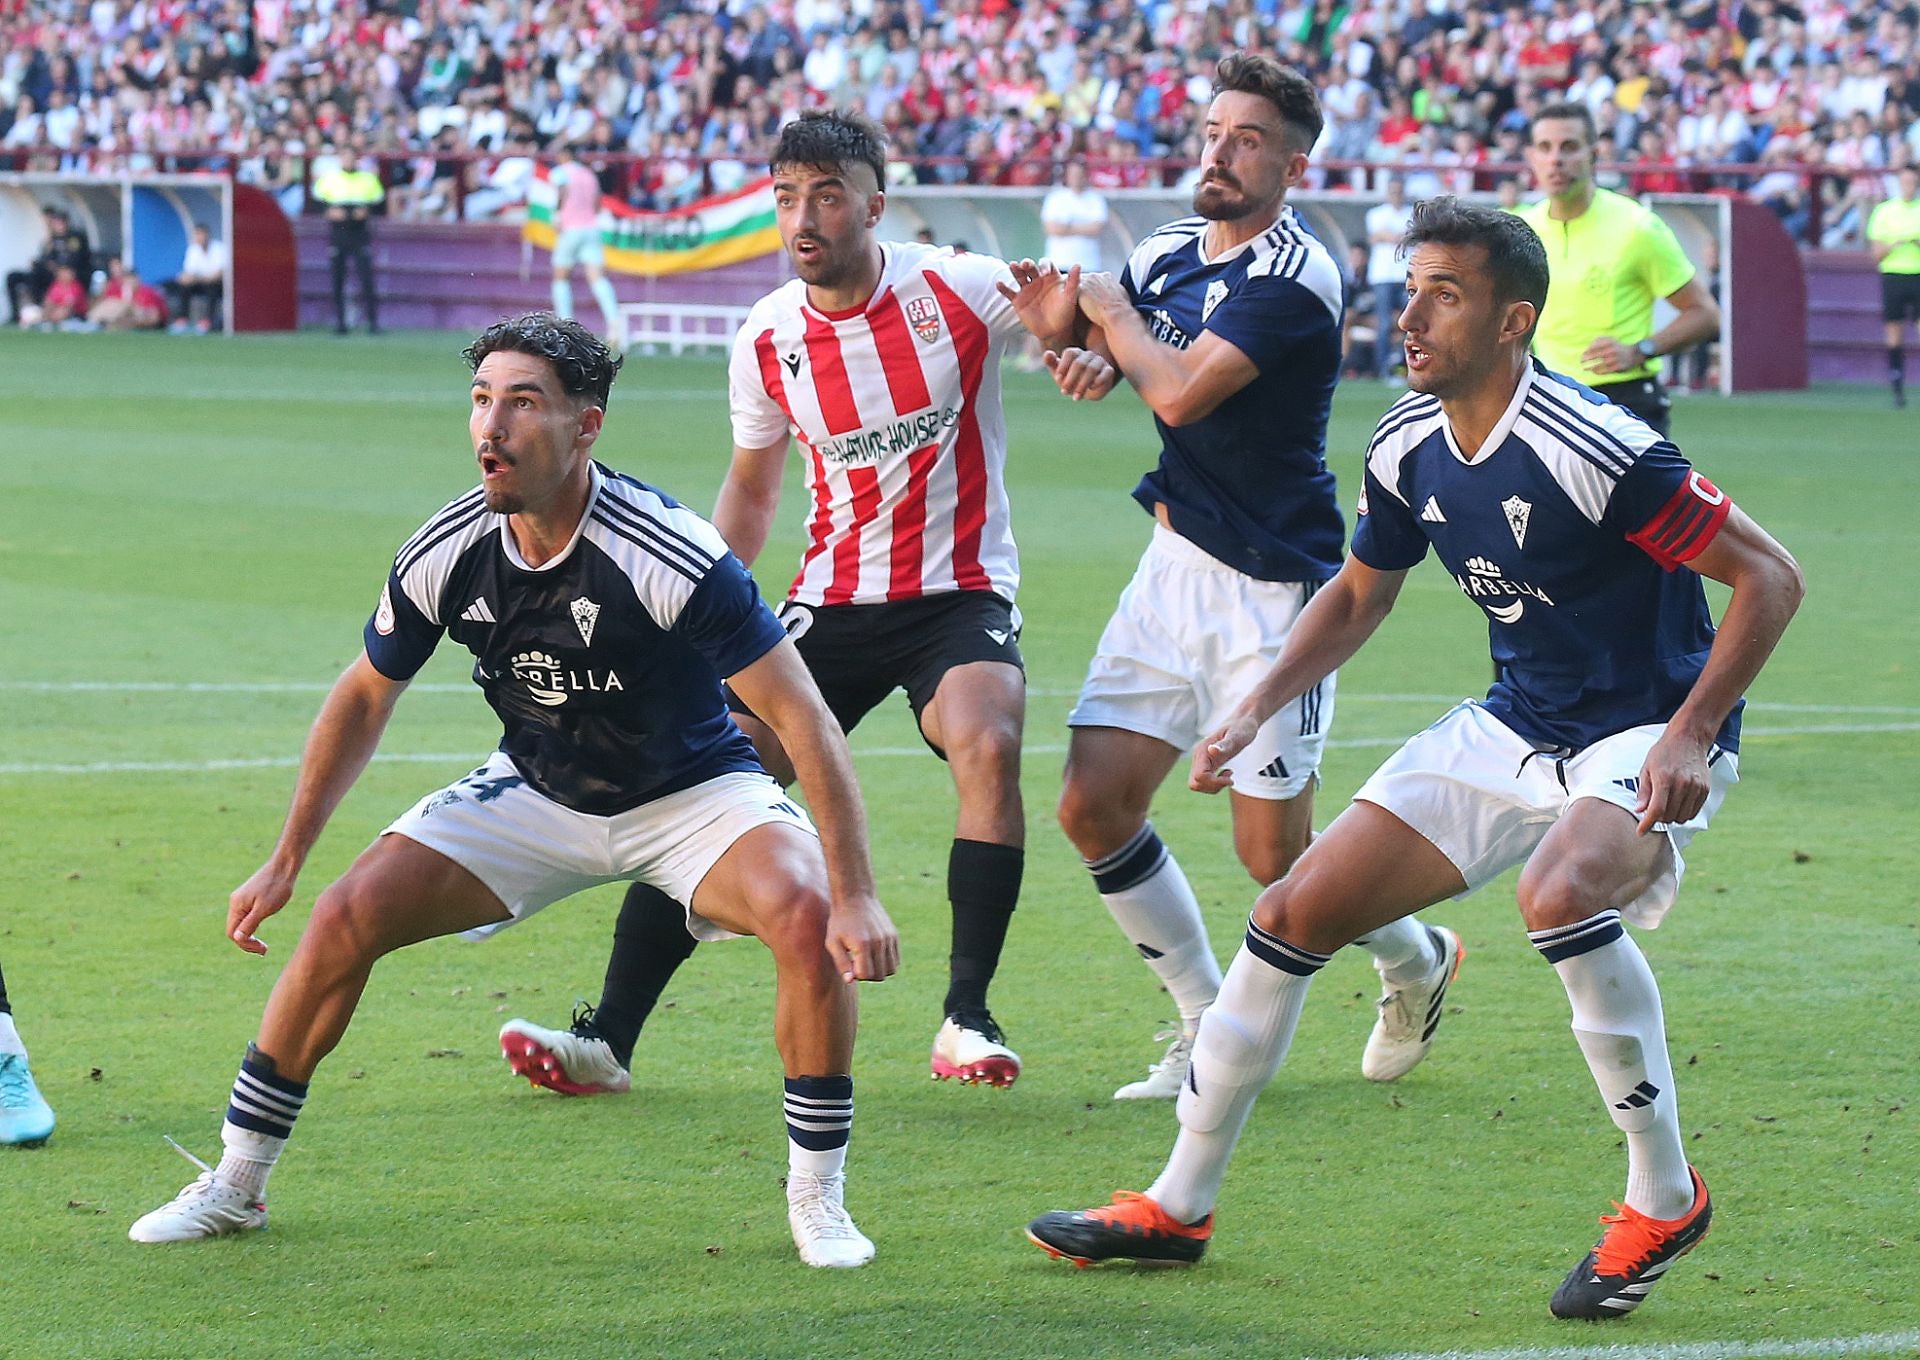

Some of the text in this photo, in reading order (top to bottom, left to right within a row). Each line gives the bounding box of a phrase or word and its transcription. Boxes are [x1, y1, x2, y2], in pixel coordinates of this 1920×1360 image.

[834, 411, 939, 463] NATUR HOUSE
[1457, 573, 1555, 607] ARBELLA
